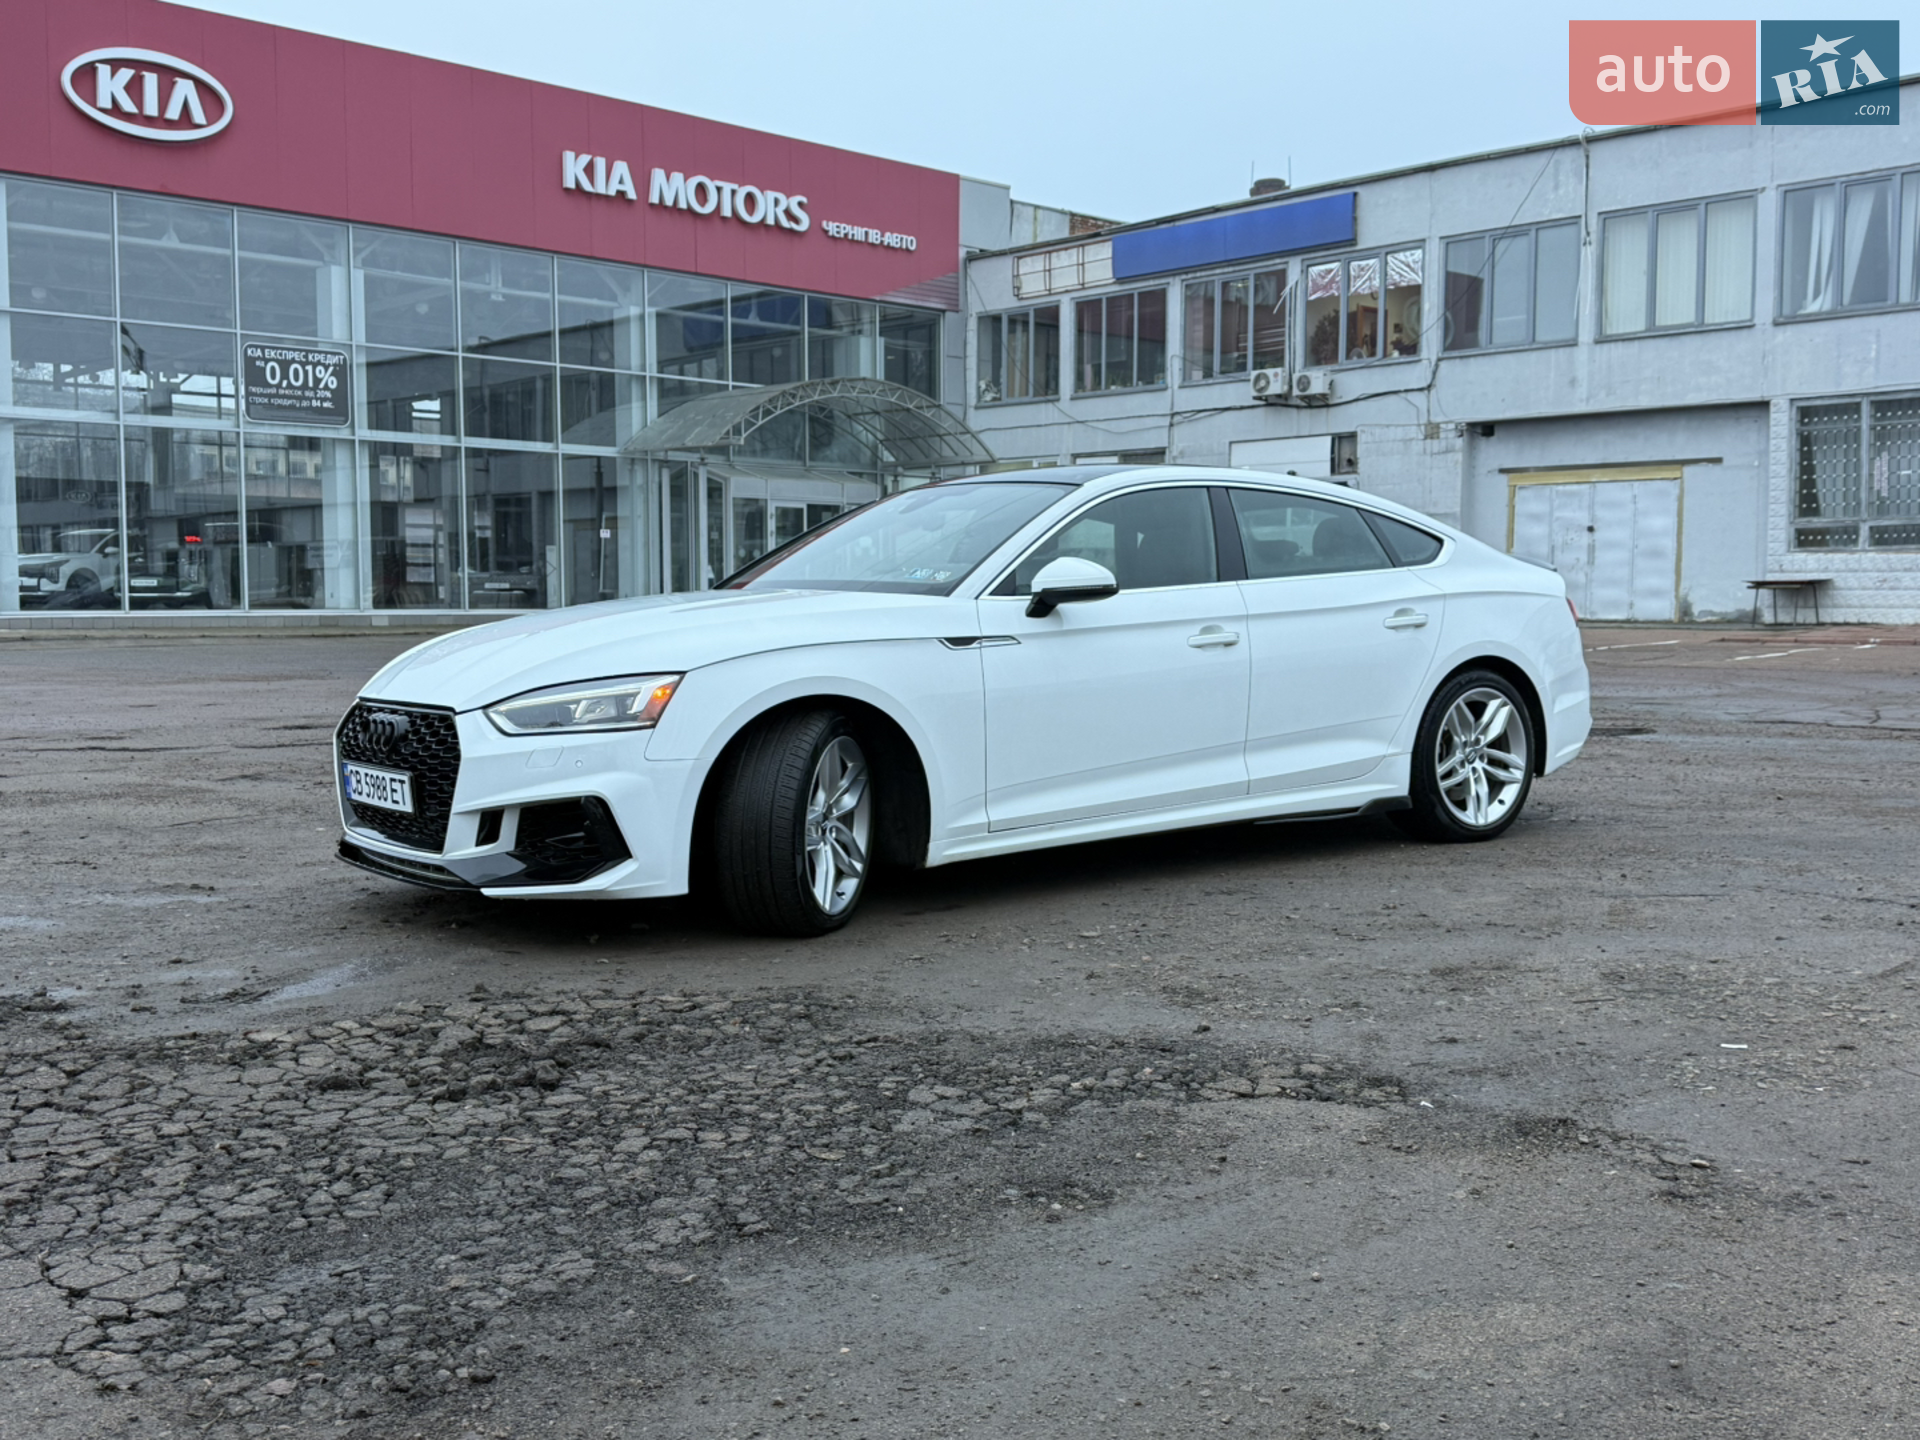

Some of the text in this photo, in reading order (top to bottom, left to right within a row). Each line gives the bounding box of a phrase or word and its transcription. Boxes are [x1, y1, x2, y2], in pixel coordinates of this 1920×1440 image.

[94, 62, 208, 125] KIA
[562, 150, 810, 232] KIA MOTORS
[821, 219, 917, 251] ЧЕРНІГІВ-АВТО
[265, 349, 306, 361] ЕКСПРЕС
[308, 353, 344, 365] КРЕДИТ
[265, 361, 338, 390] 0,01%
[316, 390, 332, 398] 20%
[349, 769, 363, 796] CB
[364, 772, 389, 802] 5988
[389, 777, 406, 806] ET
